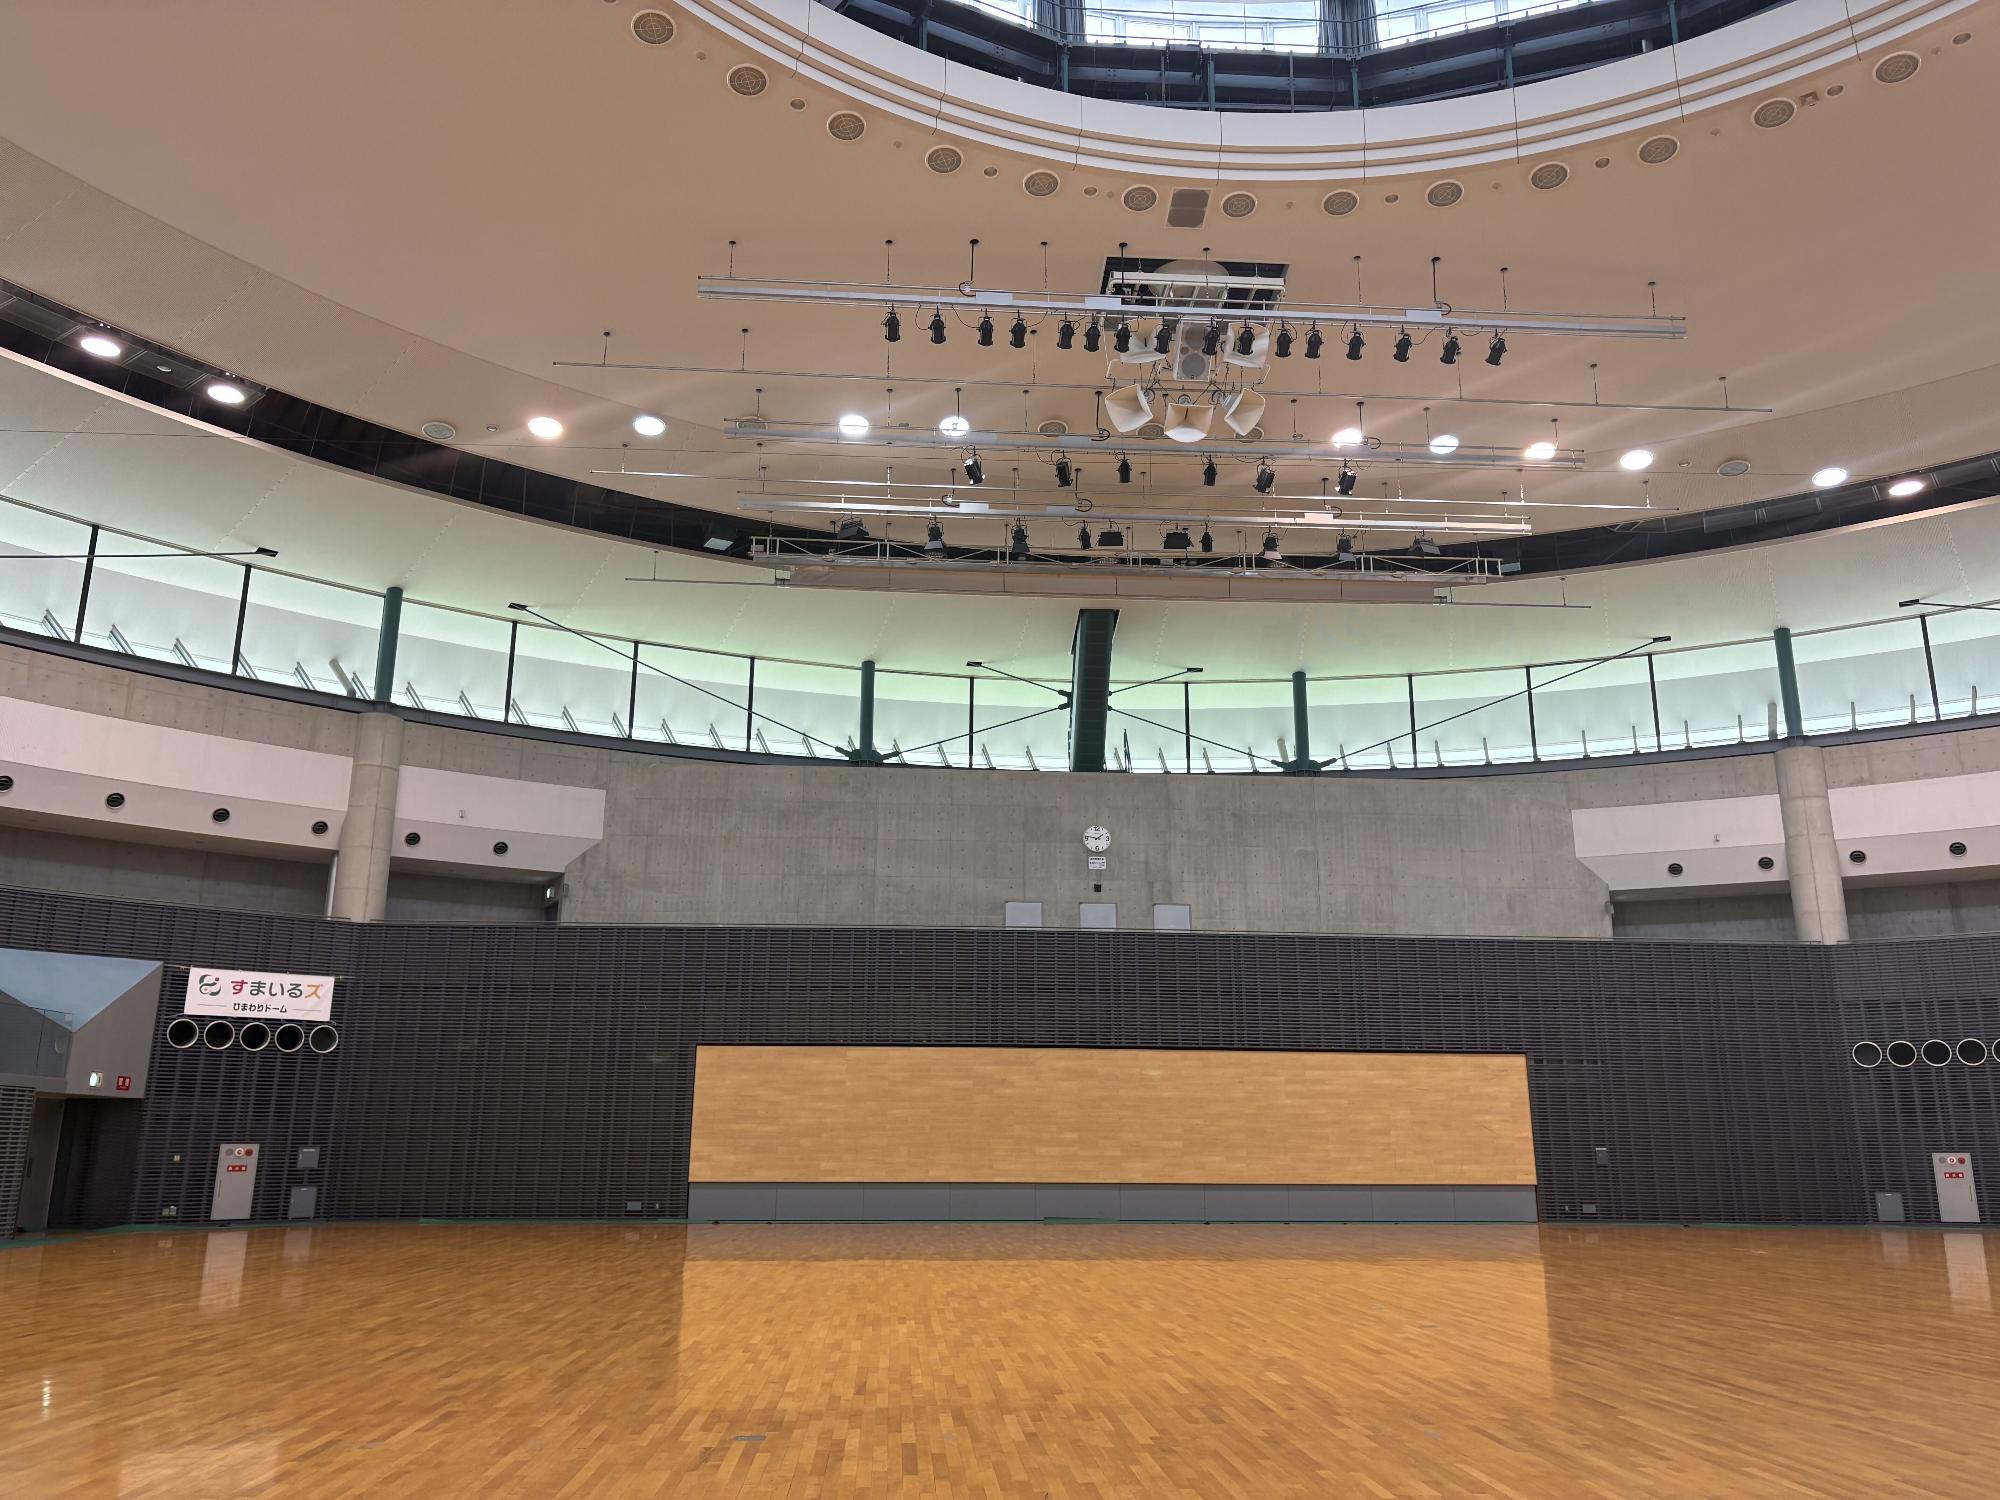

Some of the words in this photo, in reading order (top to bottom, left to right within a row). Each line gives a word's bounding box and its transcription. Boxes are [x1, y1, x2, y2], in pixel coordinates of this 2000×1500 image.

[230, 979, 323, 999] すまいるズ
[233, 1002, 287, 1013] ひまわりドーム
